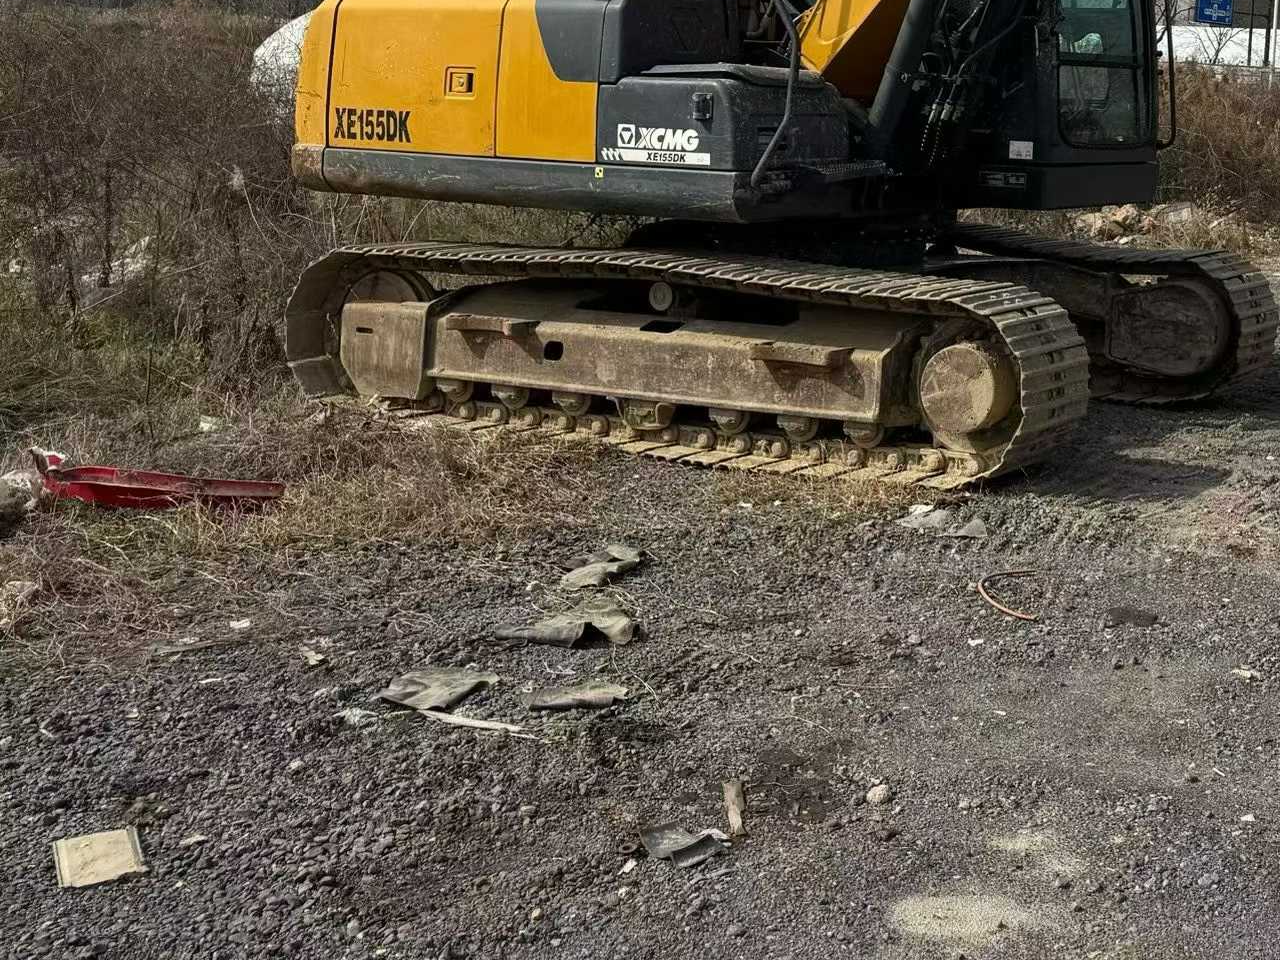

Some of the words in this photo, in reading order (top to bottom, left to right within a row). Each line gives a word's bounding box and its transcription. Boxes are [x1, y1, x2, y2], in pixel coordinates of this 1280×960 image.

[334, 107, 411, 143] XE155DK
[635, 127, 700, 151] XCMG
[646, 152, 687, 163] XE155DK
